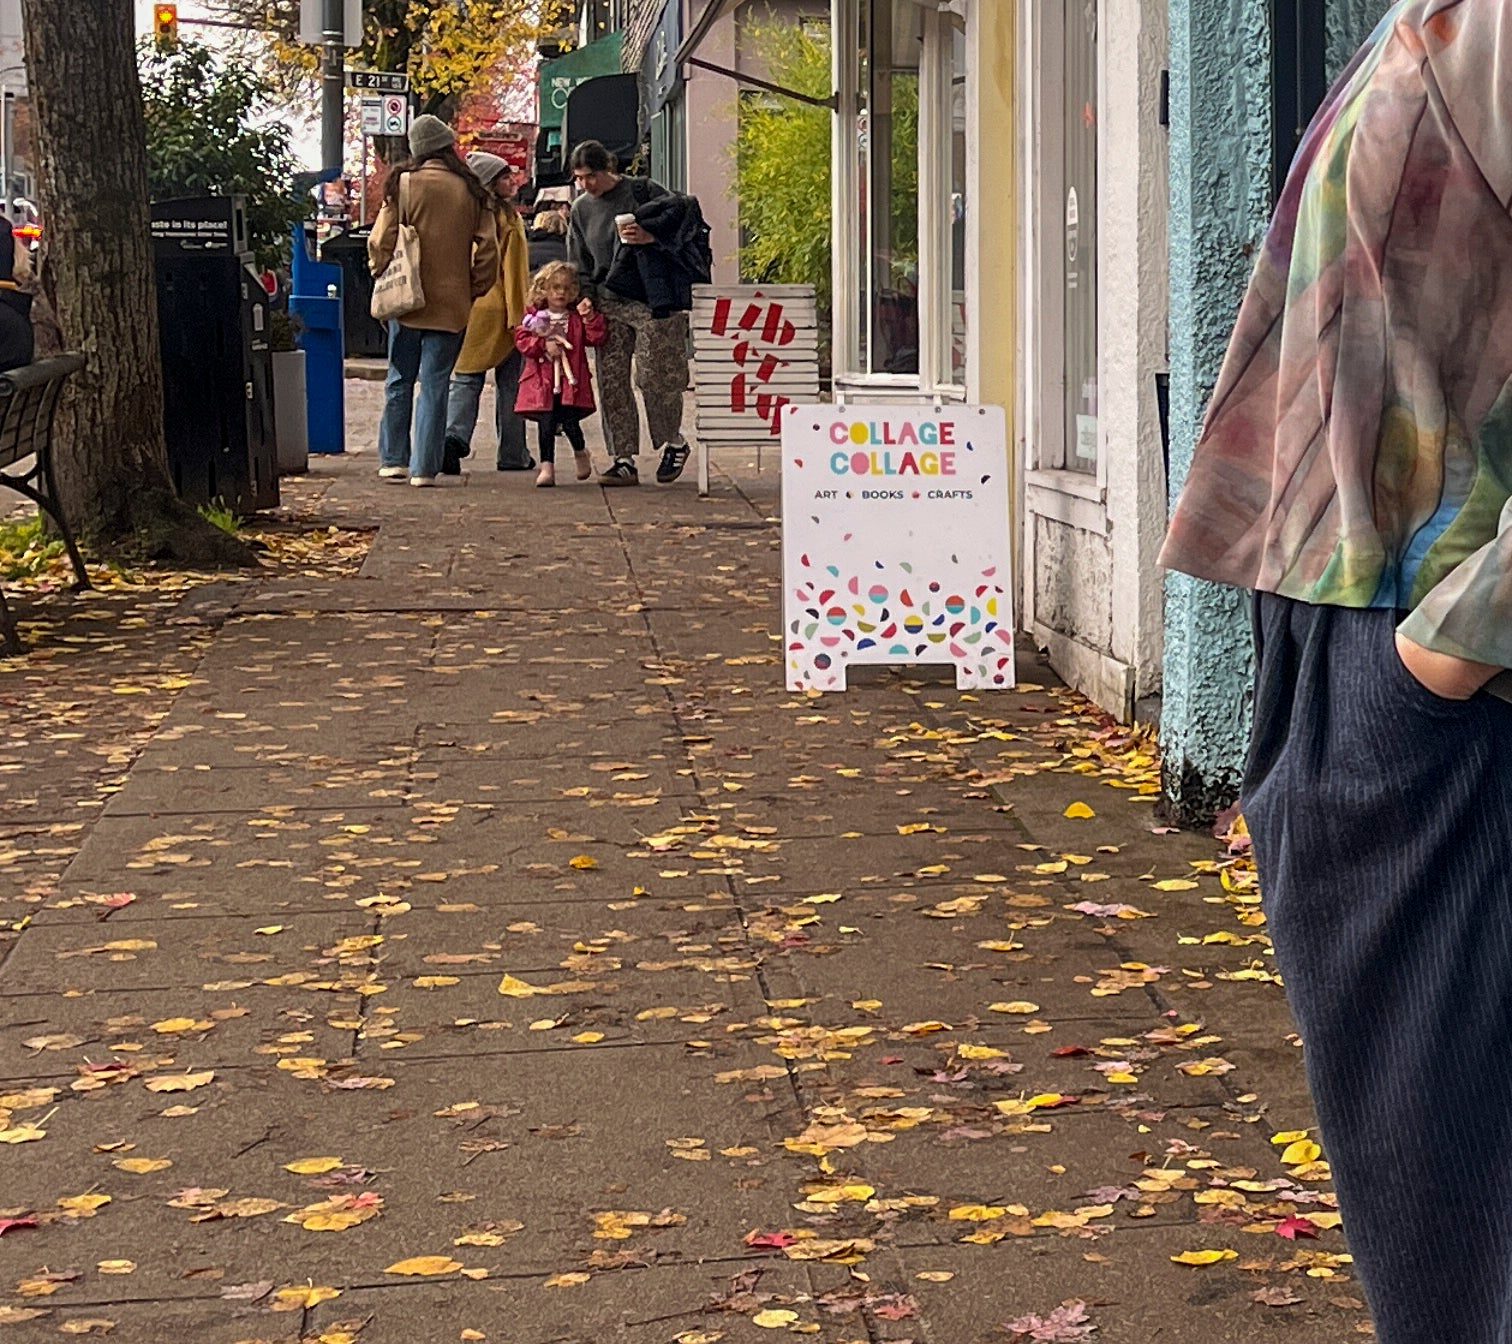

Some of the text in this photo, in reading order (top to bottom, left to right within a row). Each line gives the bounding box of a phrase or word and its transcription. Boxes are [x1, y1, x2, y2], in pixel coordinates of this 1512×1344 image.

[355, 74, 364, 87] E
[829, 421, 956, 445] COLLAGE
[830, 451, 957, 476] COLLAGE
[814, 490, 973, 500] ART BOOKS CRAFTS
